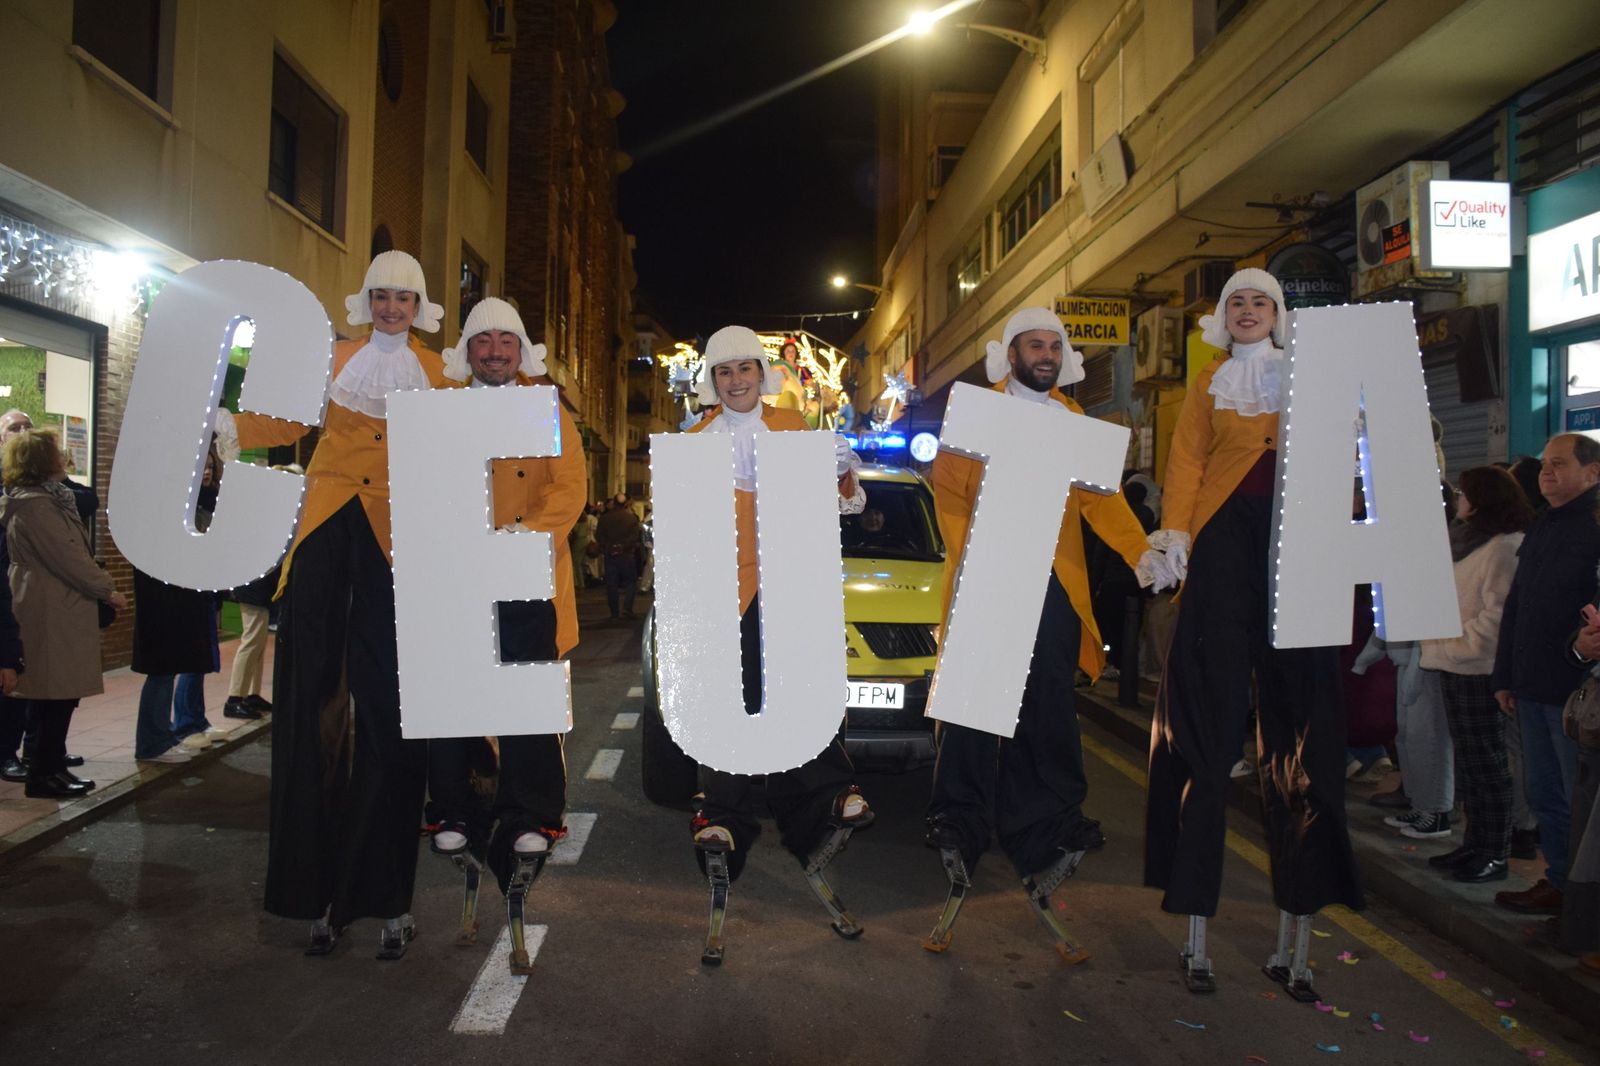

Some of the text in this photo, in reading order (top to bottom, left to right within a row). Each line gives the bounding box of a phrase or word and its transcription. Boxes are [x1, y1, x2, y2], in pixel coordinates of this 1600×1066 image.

[1458, 200, 1506, 218] Quality
[1460, 215, 1487, 229] Like
[1391, 224, 1403, 237] SE
[1055, 301, 1126, 316] ALIMENTACION
[1063, 323, 1118, 339] GARCIA
[107, 258, 1463, 775] CEUTA
